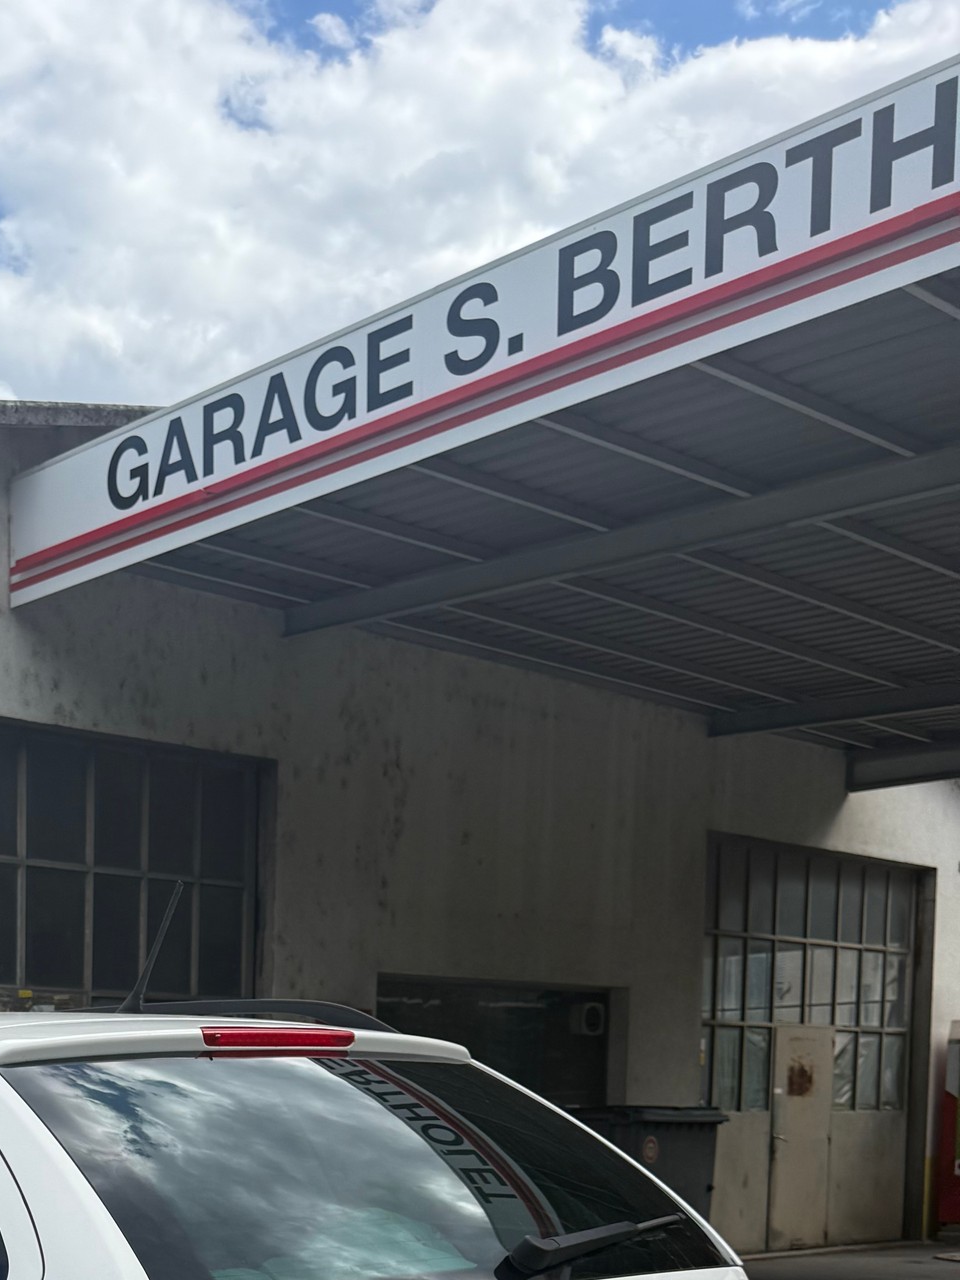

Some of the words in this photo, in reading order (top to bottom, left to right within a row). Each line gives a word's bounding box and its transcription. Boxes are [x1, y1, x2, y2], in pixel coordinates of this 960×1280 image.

[107, 314, 414, 511] GARAGE
[444, 282, 524, 377] S.
[557, 75, 959, 337] BERTH
